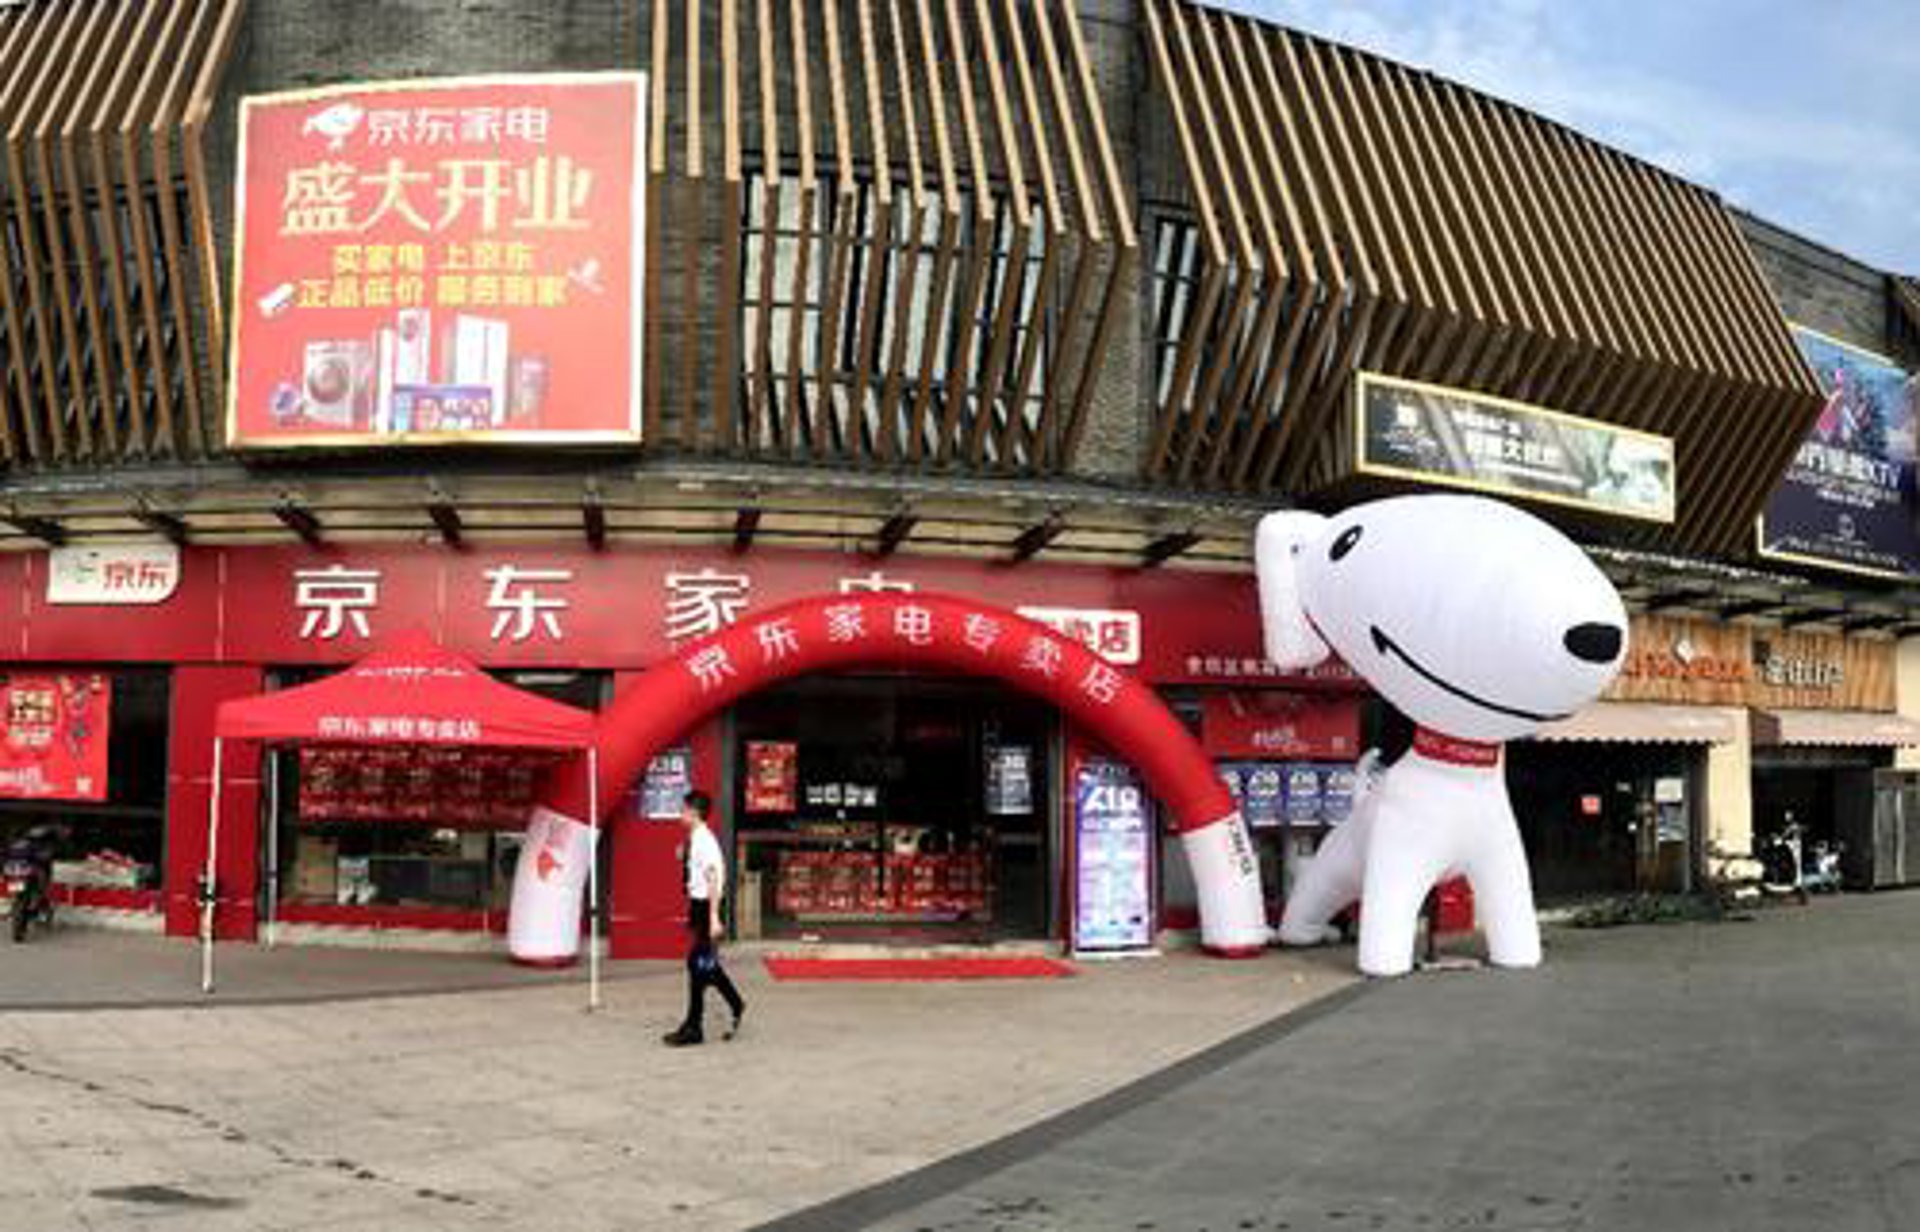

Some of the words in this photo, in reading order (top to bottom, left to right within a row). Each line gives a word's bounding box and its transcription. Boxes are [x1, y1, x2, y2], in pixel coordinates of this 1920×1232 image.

[367, 107, 549, 145] 京东家电
[278, 156, 594, 236] 盛大开业
[102, 562, 169, 589] 京东
[294, 564, 914, 641] 京东家
[688, 603, 1123, 704] 京东家电专卖店
